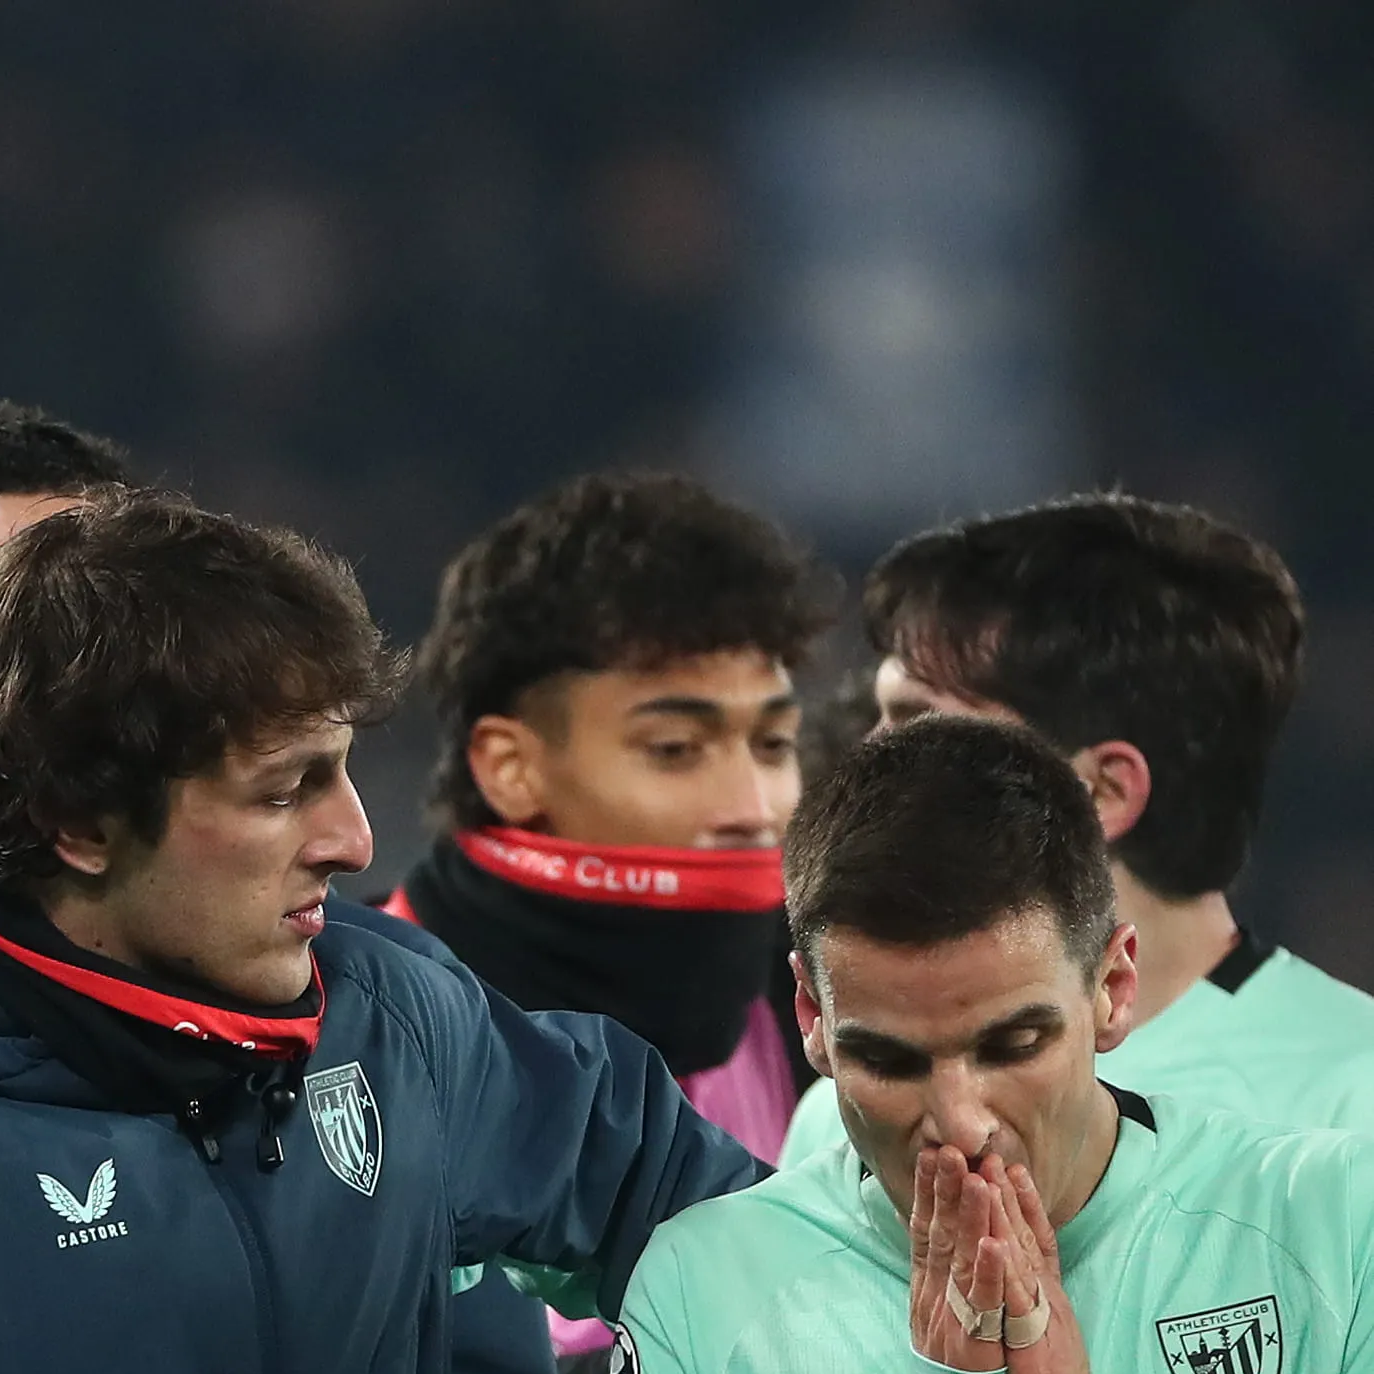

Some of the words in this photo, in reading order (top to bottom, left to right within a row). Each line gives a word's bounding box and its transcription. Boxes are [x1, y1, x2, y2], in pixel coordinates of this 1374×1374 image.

[57, 1221, 129, 1249] CASTORE
[1167, 1312, 1230, 1334] ATHLETIC
[1233, 1303, 1269, 1320] CLUB
